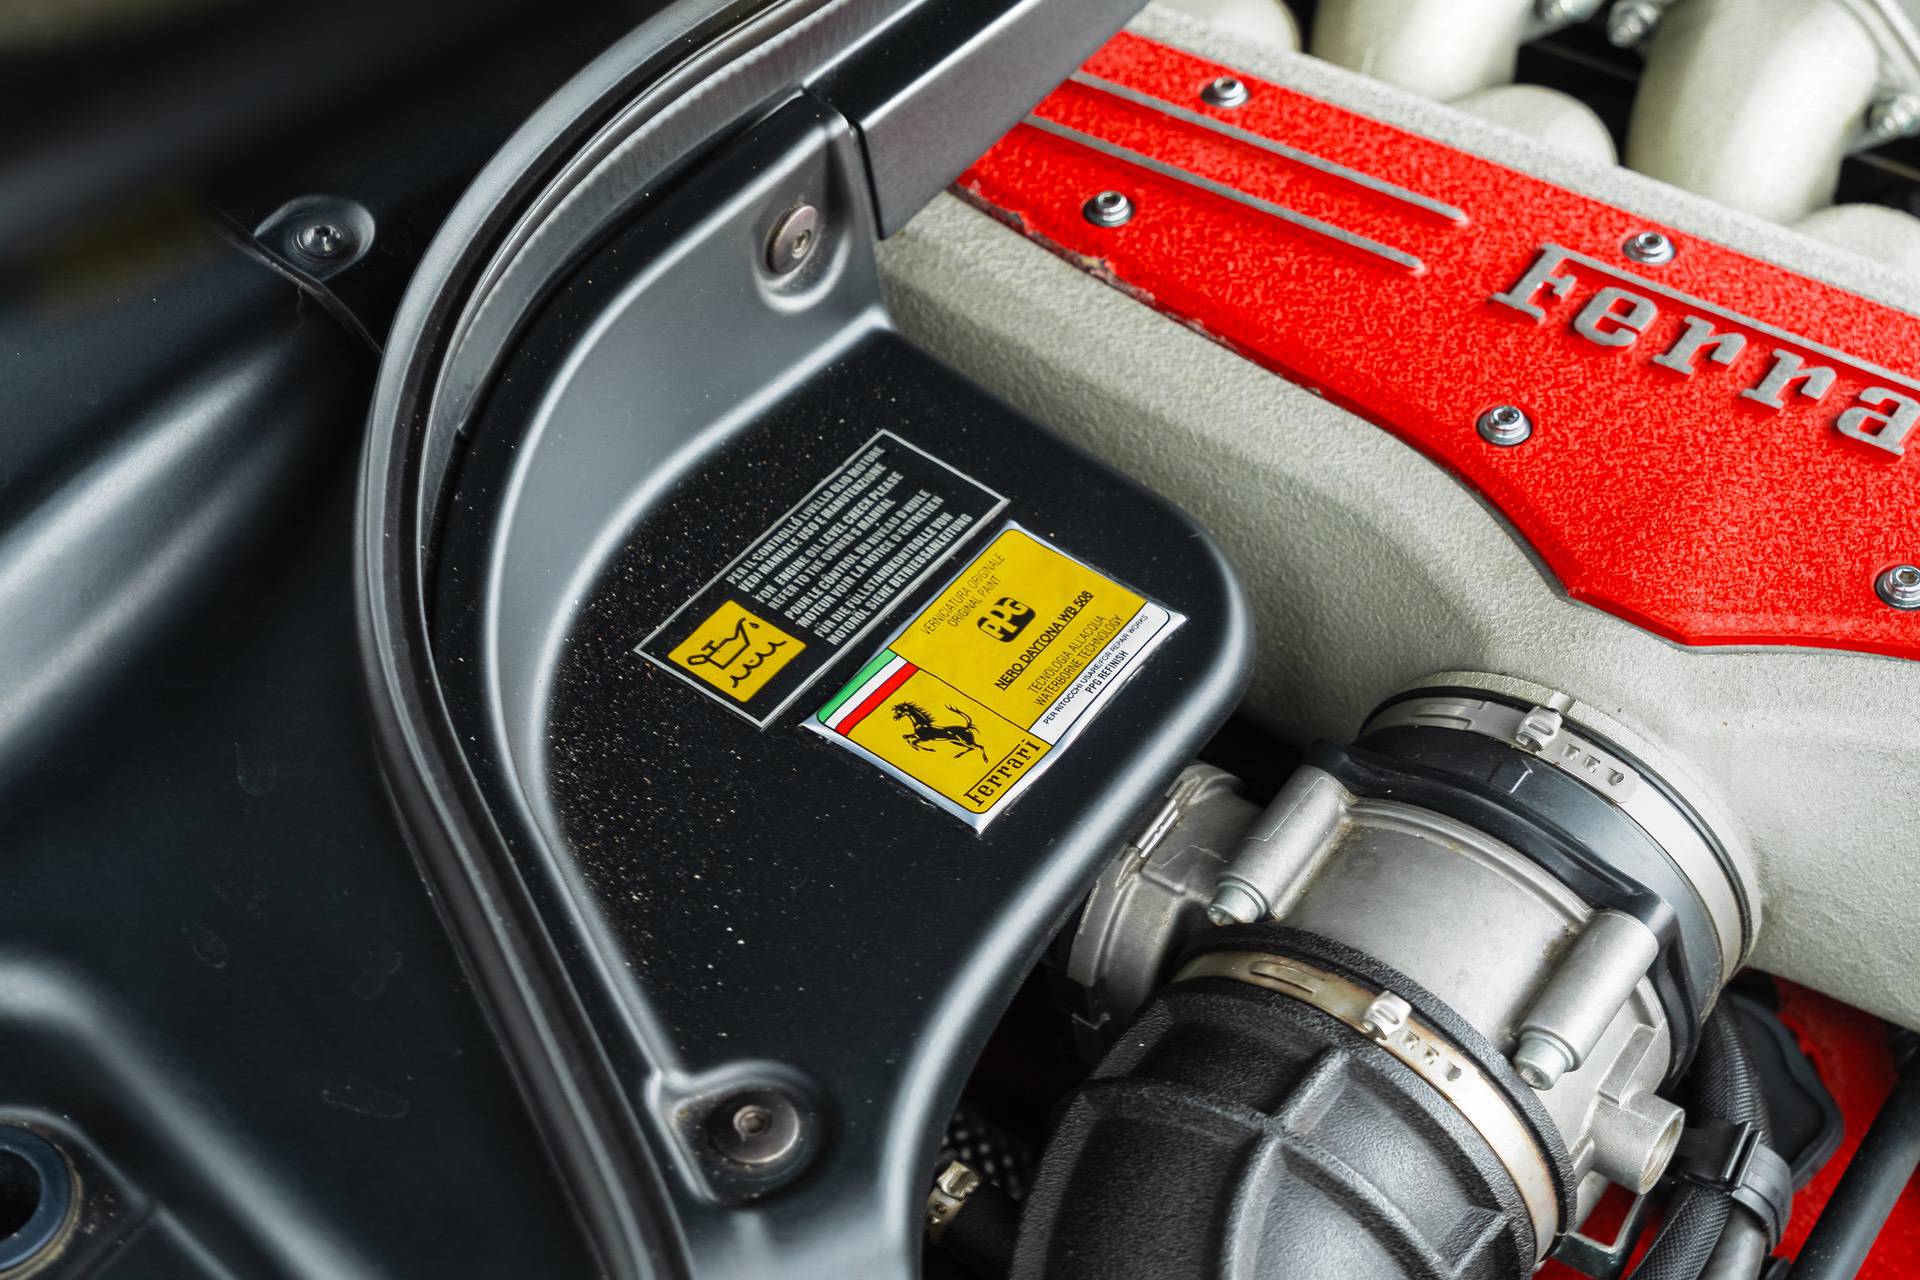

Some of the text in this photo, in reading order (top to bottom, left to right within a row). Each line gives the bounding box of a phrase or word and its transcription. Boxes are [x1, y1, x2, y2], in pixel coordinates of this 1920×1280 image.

[1490, 243, 1920, 455] Ferra
[725, 444, 886, 584] PER IL CONTROLLO LIVELLO OLIO MOTORE
[736, 570, 765, 593] VEDI
[756, 536, 804, 575] MANUALE
[794, 520, 822, 541] USO
[818, 461, 888, 520] MANUTENZIONE
[752, 470, 905, 603] FOR ENGINE OIL LEVEL CHECK PLEASE
[765, 495, 897, 610] REFER TO THE OWNER'S MANUAL
[862, 582, 897, 611] SIEHE
[886, 511, 975, 589] BETRIEBSANLEITUNG
[782, 594, 814, 620] POUR
[805, 585, 825, 600] LE
[852, 540, 873, 556] DU
[864, 514, 902, 546] NIVEAU
[794, 592, 838, 629] MOTEUR
[828, 574, 857, 598] VOIR
[848, 563, 869, 579] LA
[859, 537, 898, 569] NOTICE
[808, 616, 838, 638] FÜR
[829, 604, 852, 623] DIE
[929, 510, 955, 531] VON
[918, 551, 1007, 636] VERNICIATURA ORIGINALE
[945, 573, 1004, 628] ORIGINAL PAINT
[976, 597, 1036, 643] PPG
[992, 589, 1095, 691] NERO DAYTONA WB 508
[1031, 613, 1125, 707] WATERBORNE TECHNOLOGY
[1041, 709, 1058, 725] PER
[1053, 681, 1084, 712] RITOCCHI
[1108, 632, 1131, 653] REPAIR
[1126, 613, 1149, 634] WORKS
[1025, 649, 1073, 695] TECNOLOGIA
[1083, 649, 1129, 694] PPG REFINISH
[963, 739, 1041, 807] Ferrari
